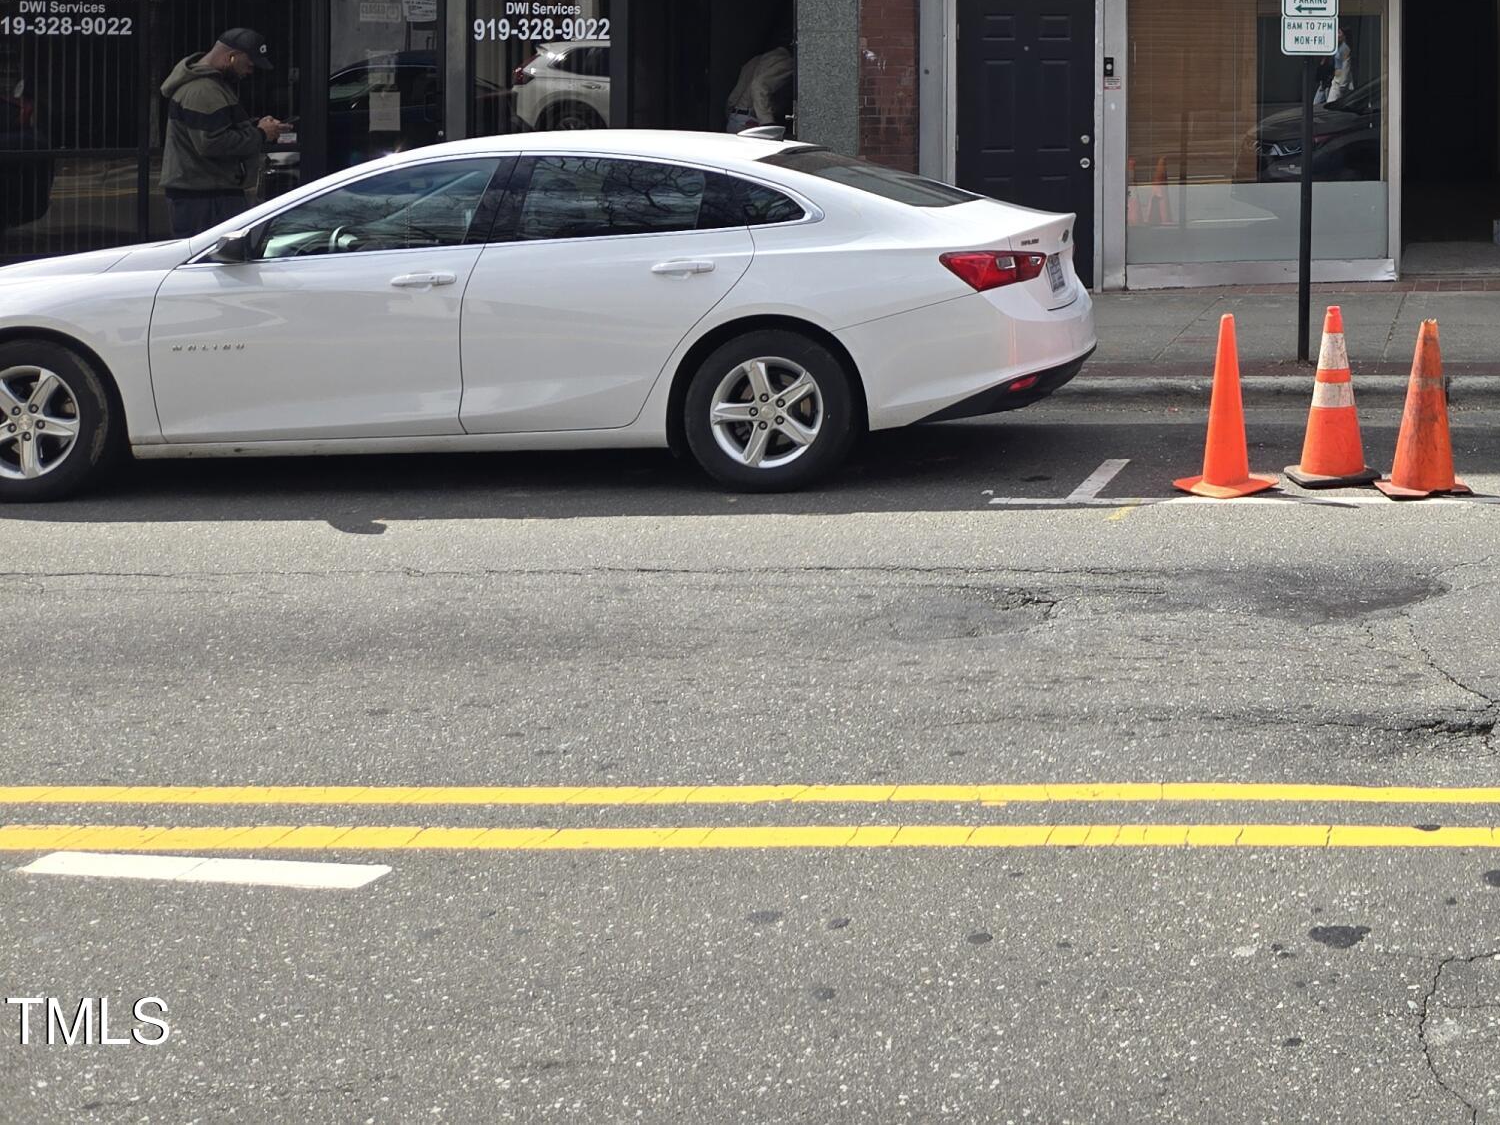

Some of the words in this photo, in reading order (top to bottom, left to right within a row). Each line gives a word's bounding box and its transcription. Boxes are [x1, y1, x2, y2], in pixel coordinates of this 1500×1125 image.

[20, 1, 46, 13] DWI
[50, 1, 106, 14] Services
[506, 2, 530, 15] DWI
[532, 2, 582, 15] Services
[473, 18, 611, 41] 919-328-9022
[1286, 21, 1303, 30] 8AM
[1305, 21, 1315, 30] TO
[1317, 21, 1333, 30] 7PM
[1293, 36, 1326, 45] MON-FRI
